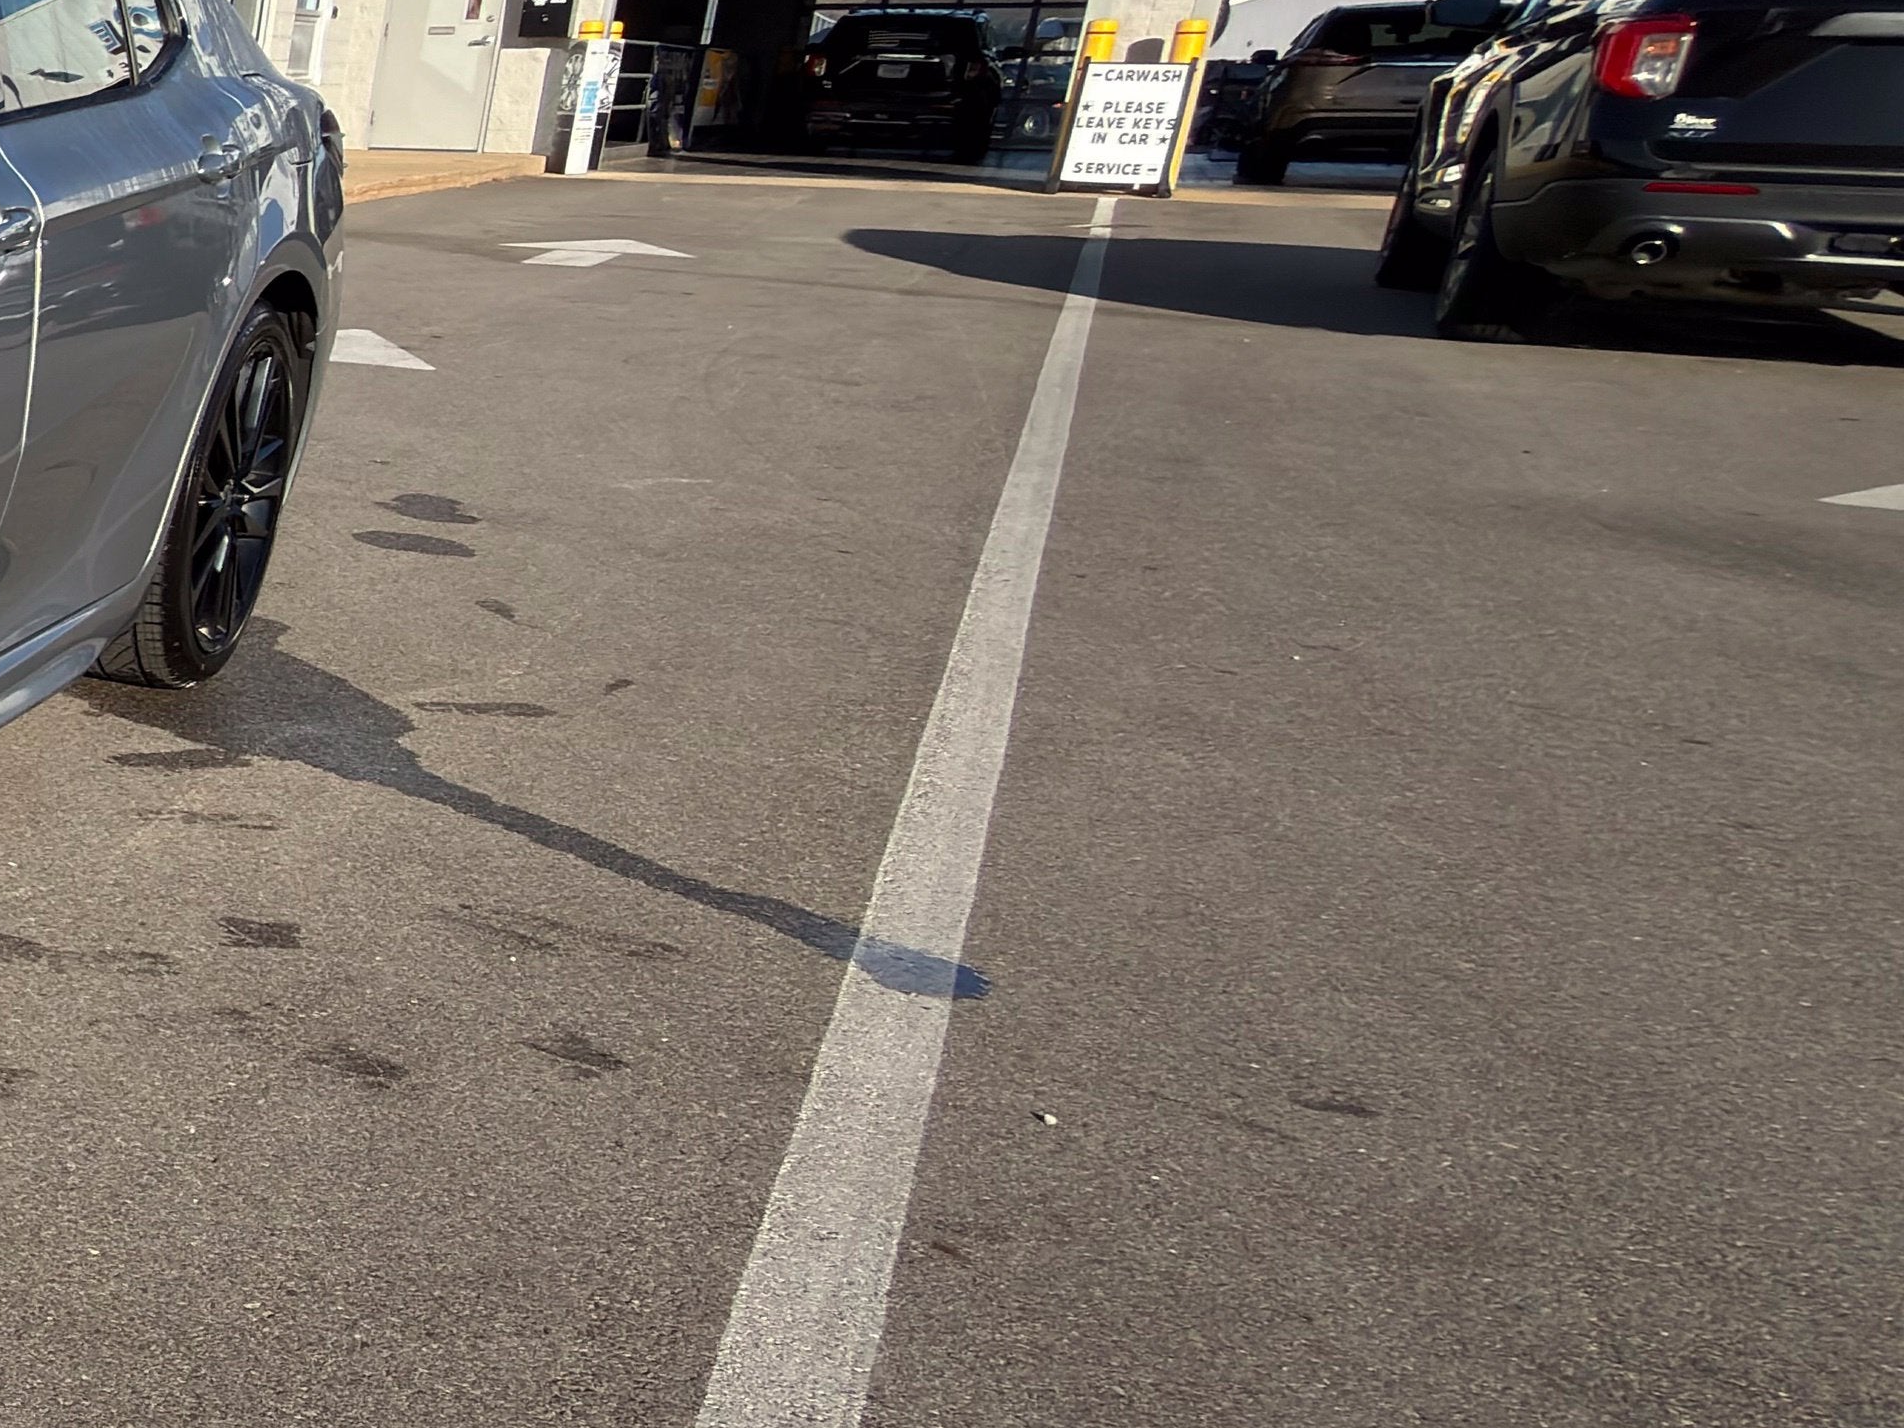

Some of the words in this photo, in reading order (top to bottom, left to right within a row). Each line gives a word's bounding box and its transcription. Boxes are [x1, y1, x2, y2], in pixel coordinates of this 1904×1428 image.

[1104, 69, 1182, 82] CARWASH
[1102, 101, 1166, 114] PLEASE
[1075, 116, 1126, 128] LEAVE
[1132, 117, 1177, 130] KEYS
[1091, 132, 1107, 144] IN
[1118, 133, 1149, 145] CAR
[1072, 162, 1142, 175] SERVICE
